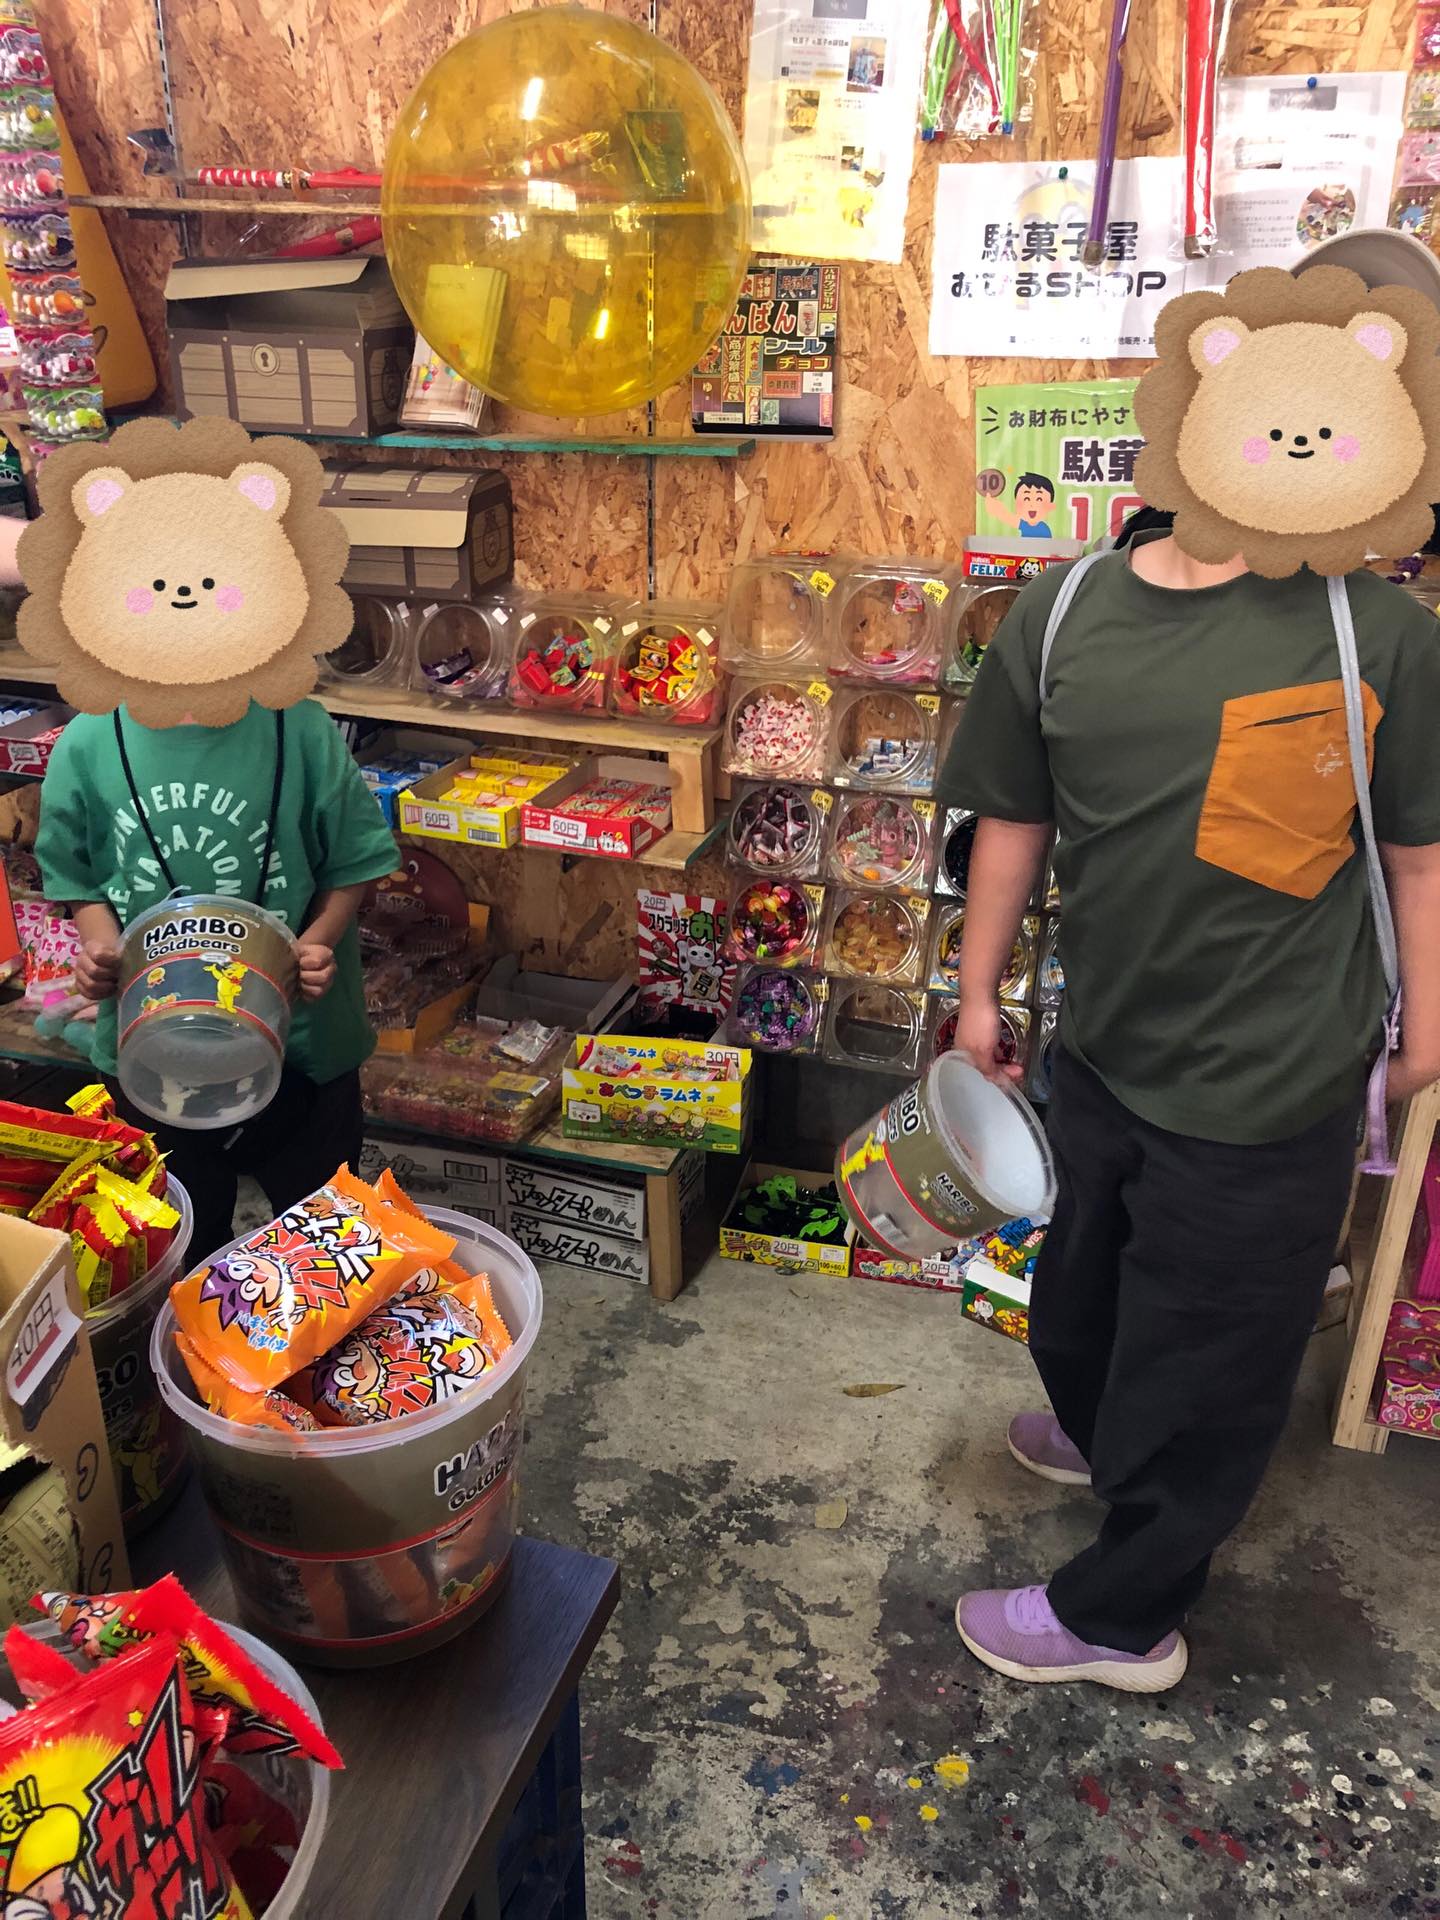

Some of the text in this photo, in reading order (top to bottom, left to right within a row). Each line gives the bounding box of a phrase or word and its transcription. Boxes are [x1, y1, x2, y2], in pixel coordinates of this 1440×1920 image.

[764, 337, 826, 355] シール
[777, 355, 832, 371] チョコ
[749, 387, 761, 424] SALE
[1009, 408, 1130, 428] お財布にやさ
[970, 563, 1008, 577] FELIX
[424, 811, 451, 826] 60円
[552, 819, 580, 837] 60円
[643, 895, 667, 909] 20円
[145, 917, 248, 949] HARIBO
[147, 937, 241, 961] Goldbears
[706, 1050, 740, 1067] 30円
[937, 1173, 979, 1215] HARIBO
[773, 1240, 800, 1255] 20円
[923, 1261, 951, 1275] 20円
[11, 1292, 55, 1370] 40円
